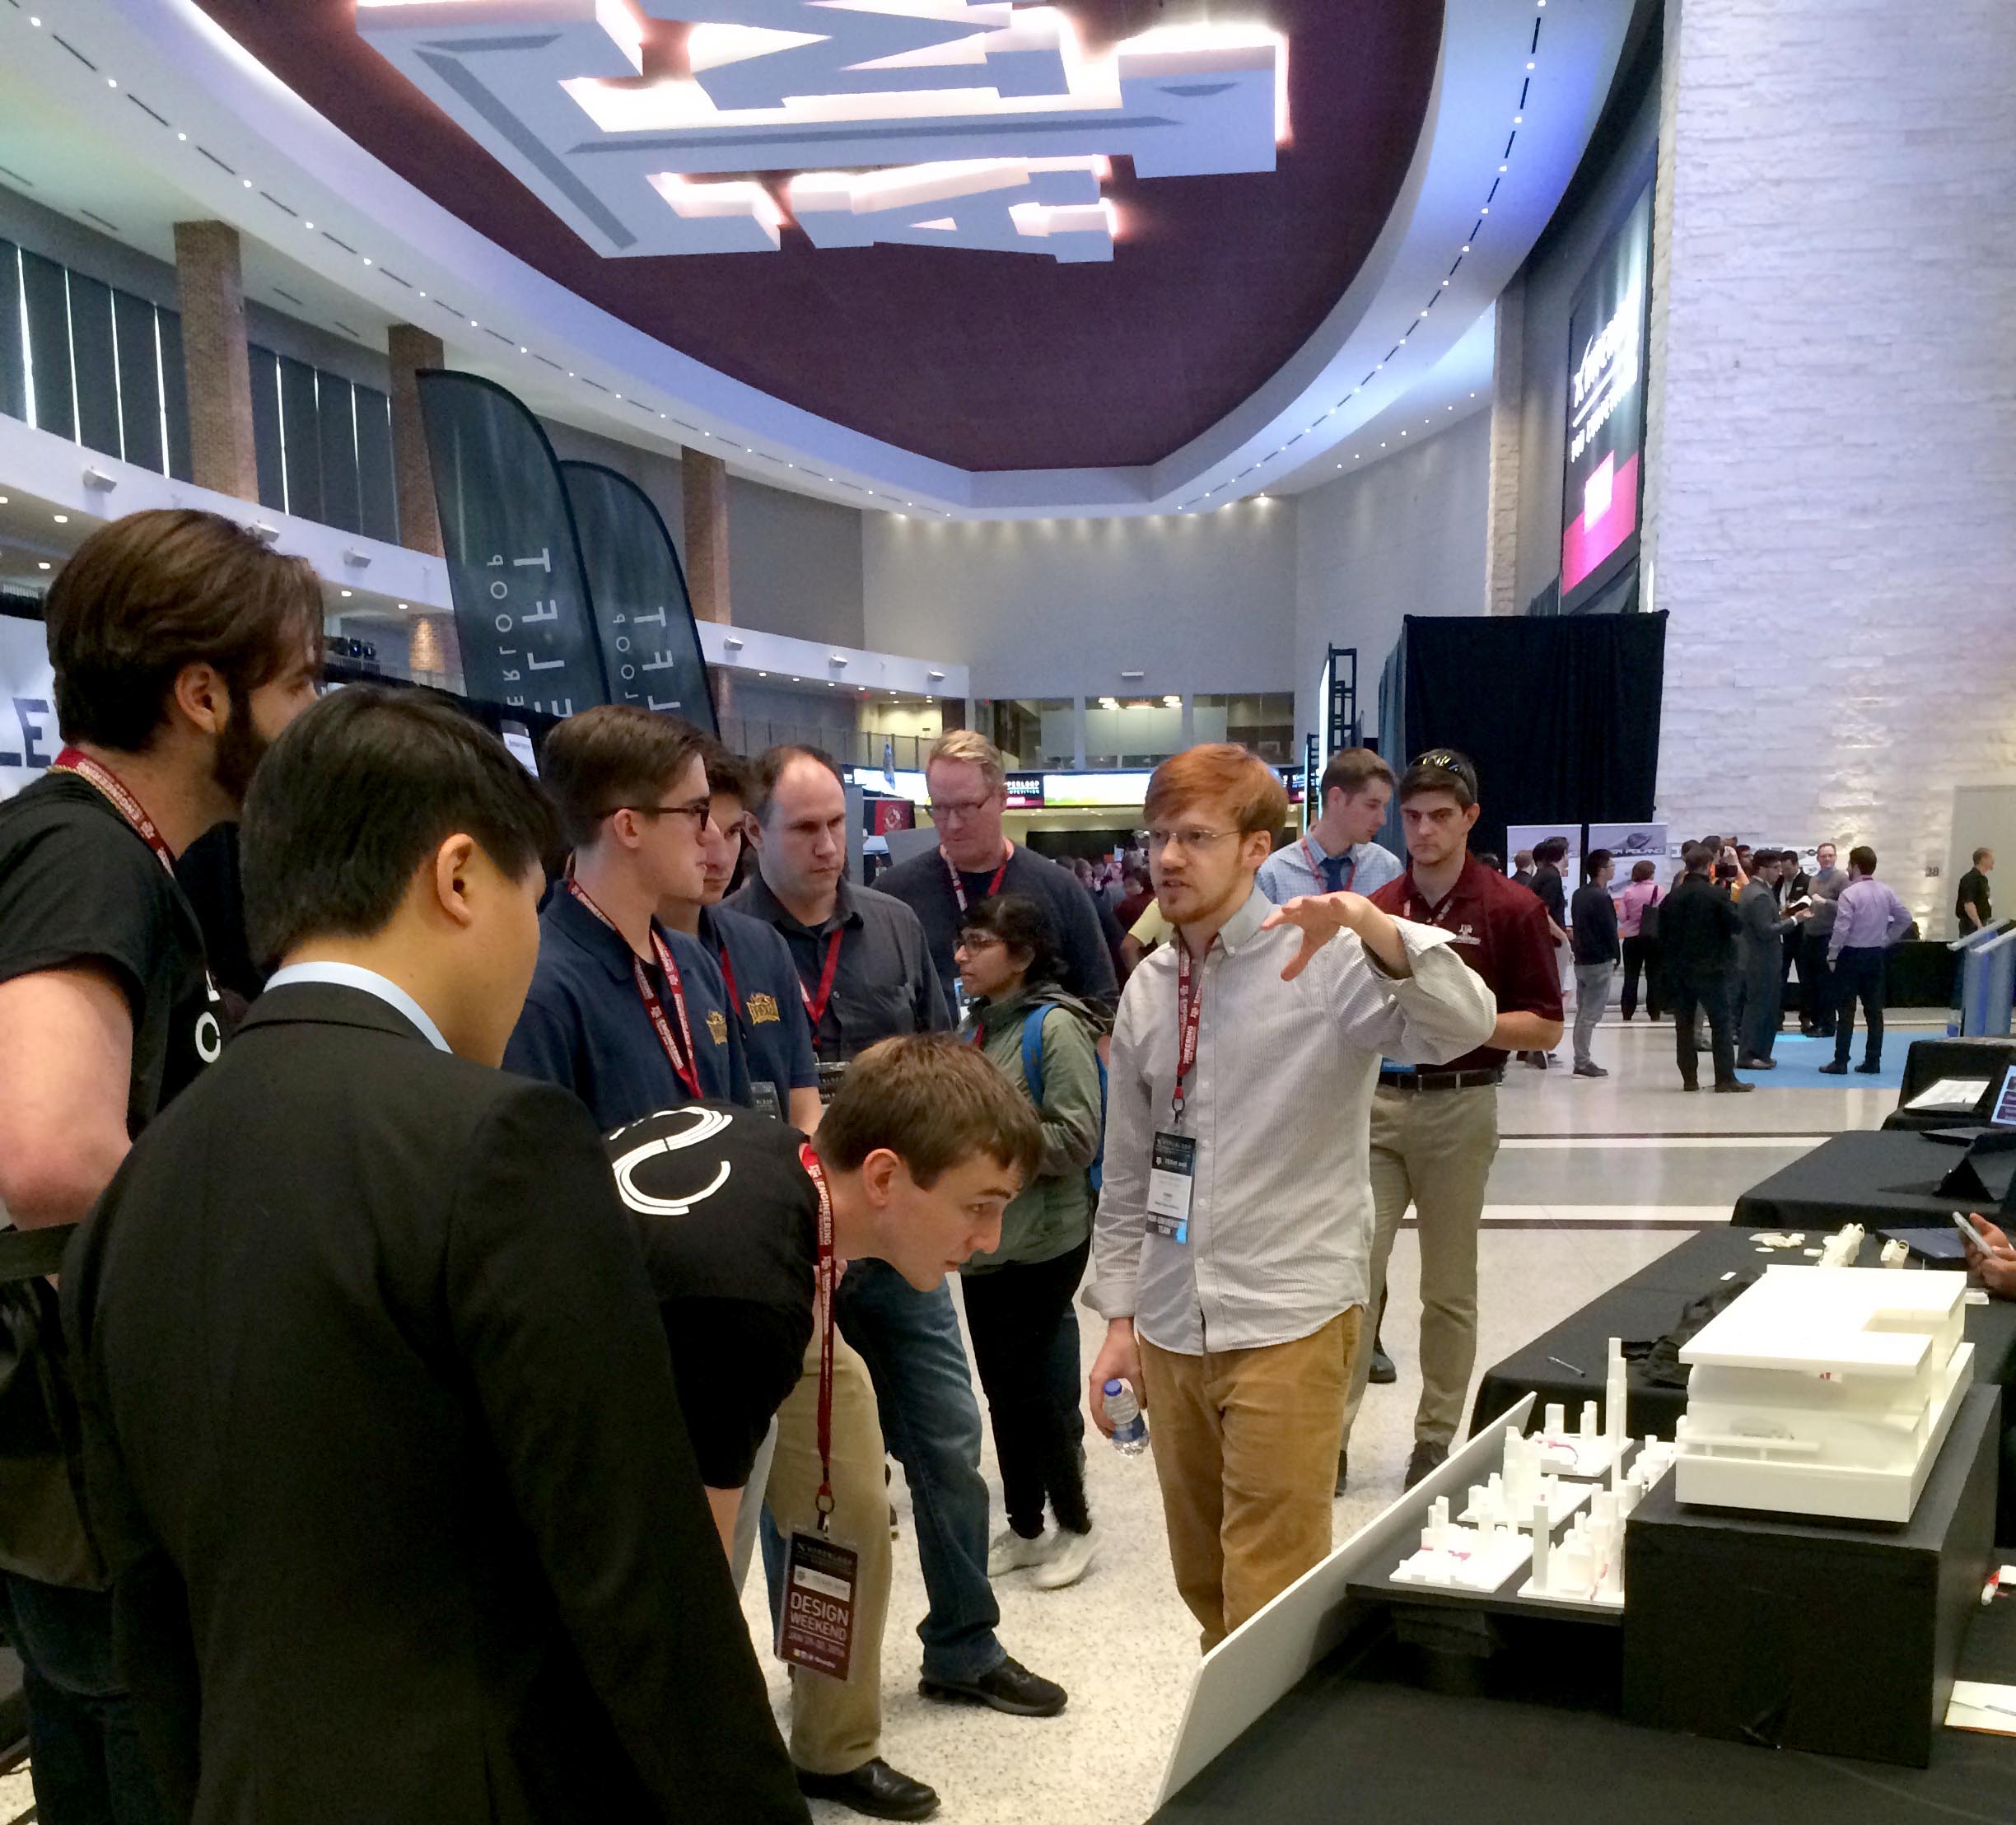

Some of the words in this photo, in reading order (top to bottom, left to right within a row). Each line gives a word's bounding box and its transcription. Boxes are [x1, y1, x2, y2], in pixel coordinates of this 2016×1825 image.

[817, 1180, 833, 1246] ENGINEERING
[790, 1592, 849, 1627] DESIGN
[790, 1611, 847, 1641] WEEKEND
